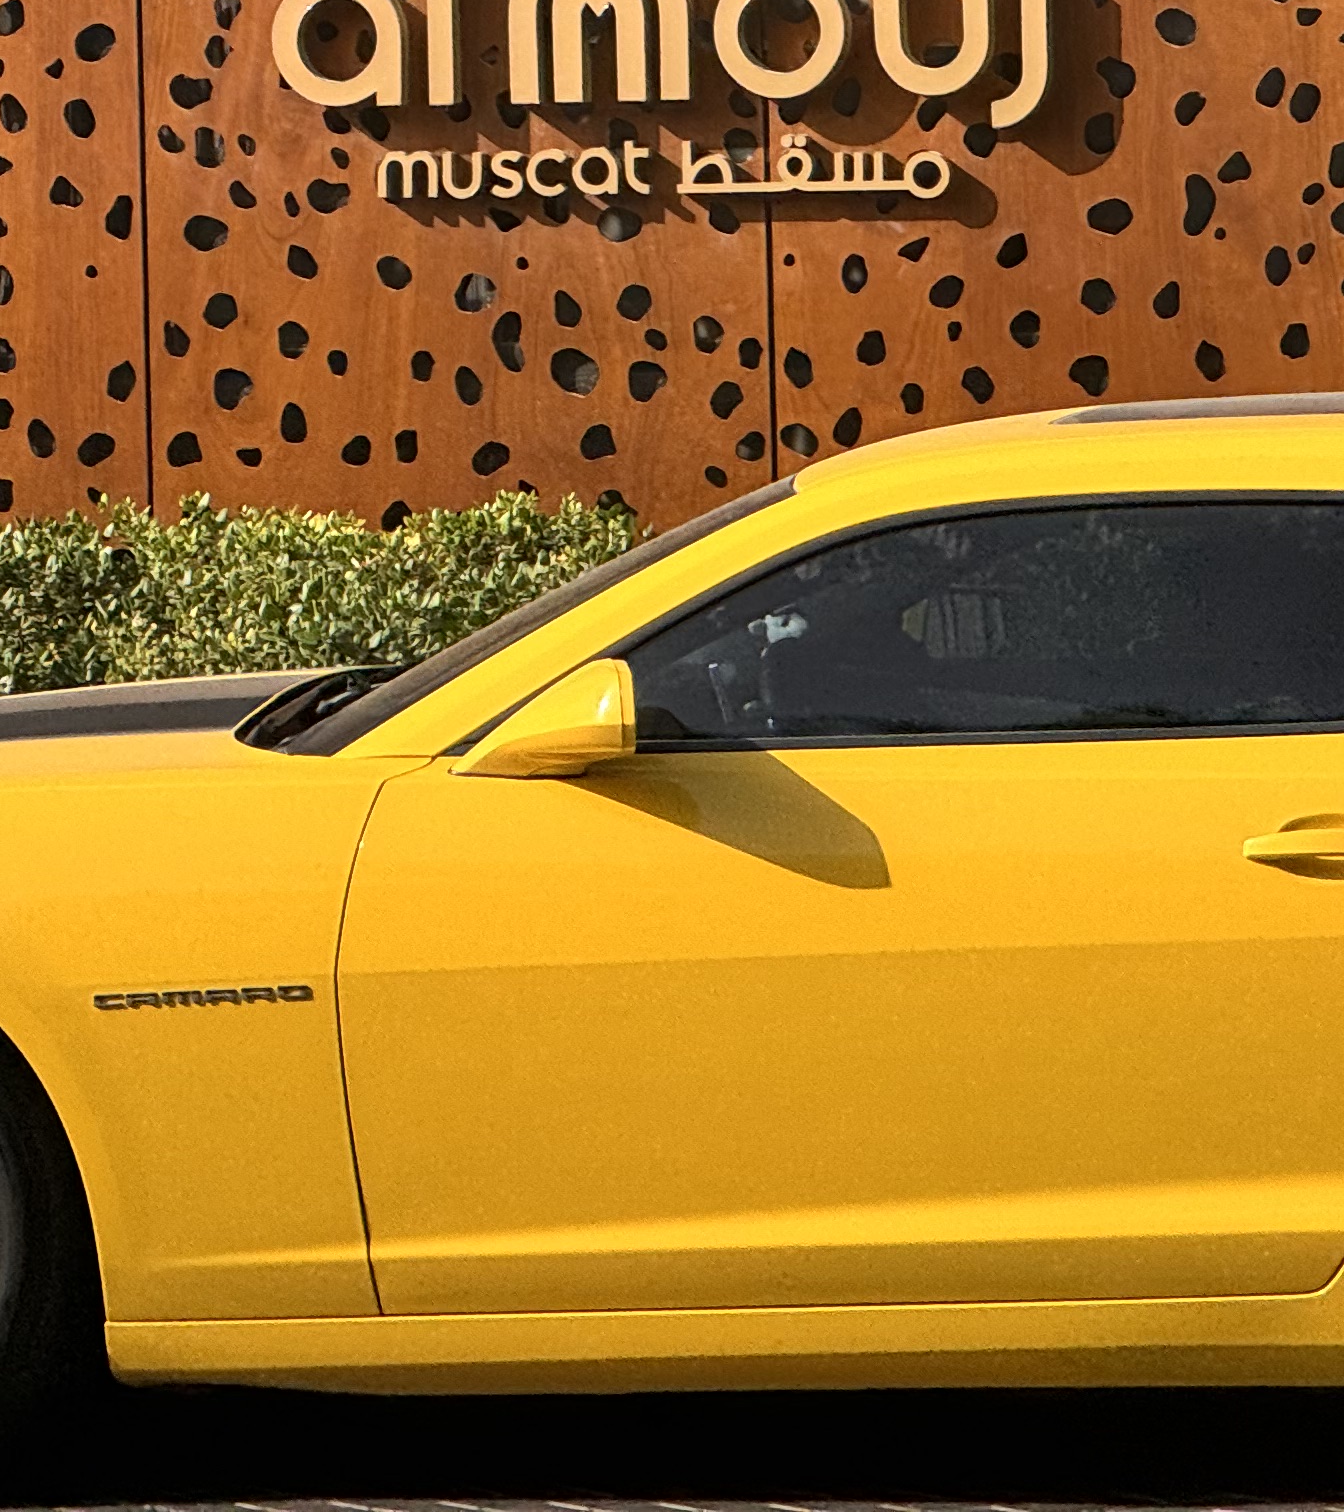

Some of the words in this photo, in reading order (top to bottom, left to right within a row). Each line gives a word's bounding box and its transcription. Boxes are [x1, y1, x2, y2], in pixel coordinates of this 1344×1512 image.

[376, 140, 651, 199] muscat
[676, 133, 952, 199] مسقط
[93, 985, 315, 1011] CAMARO
